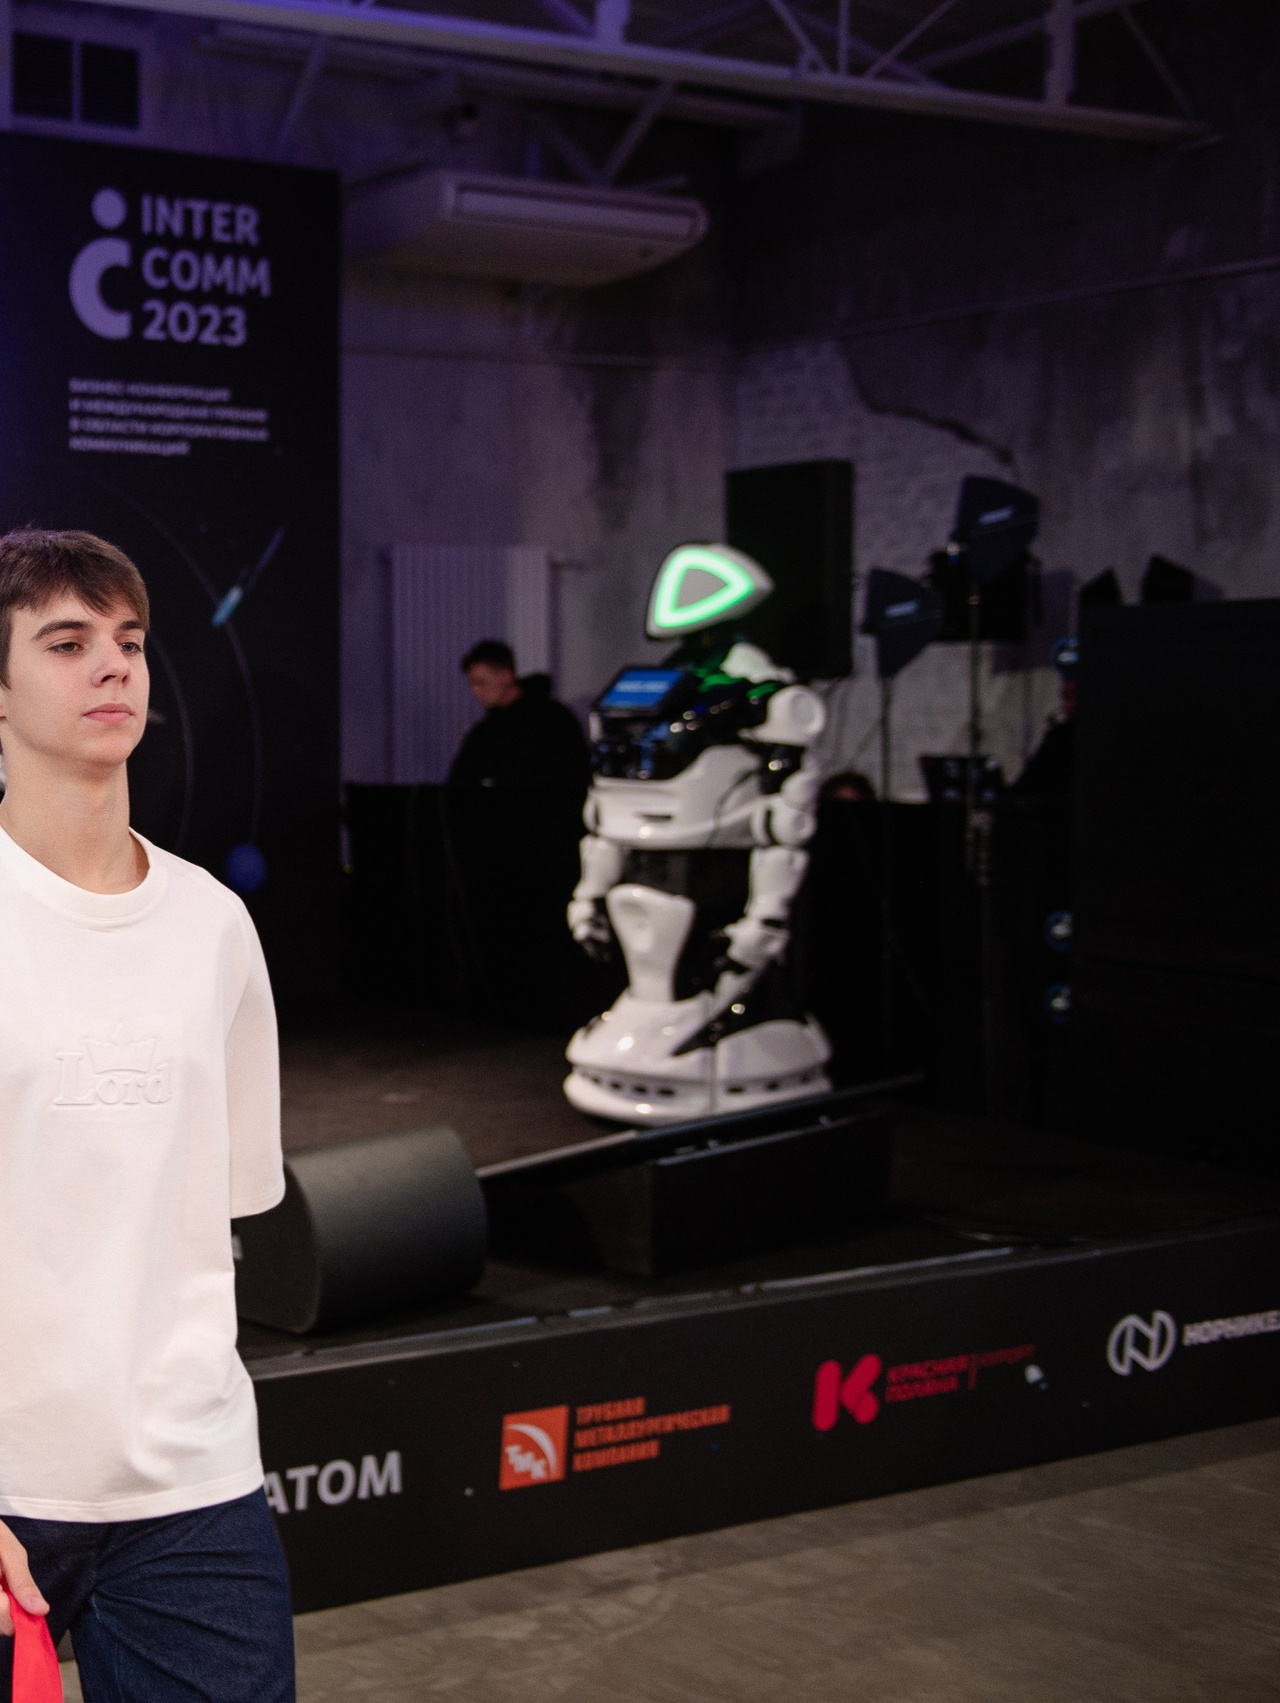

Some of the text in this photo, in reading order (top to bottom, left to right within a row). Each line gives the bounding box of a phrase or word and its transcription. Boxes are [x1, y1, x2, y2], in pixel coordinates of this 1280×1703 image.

[140, 193, 260, 246] INTER
[141, 246, 270, 298] COMM
[142, 298, 247, 347] 2023
[53, 1051, 172, 1107] Lord
